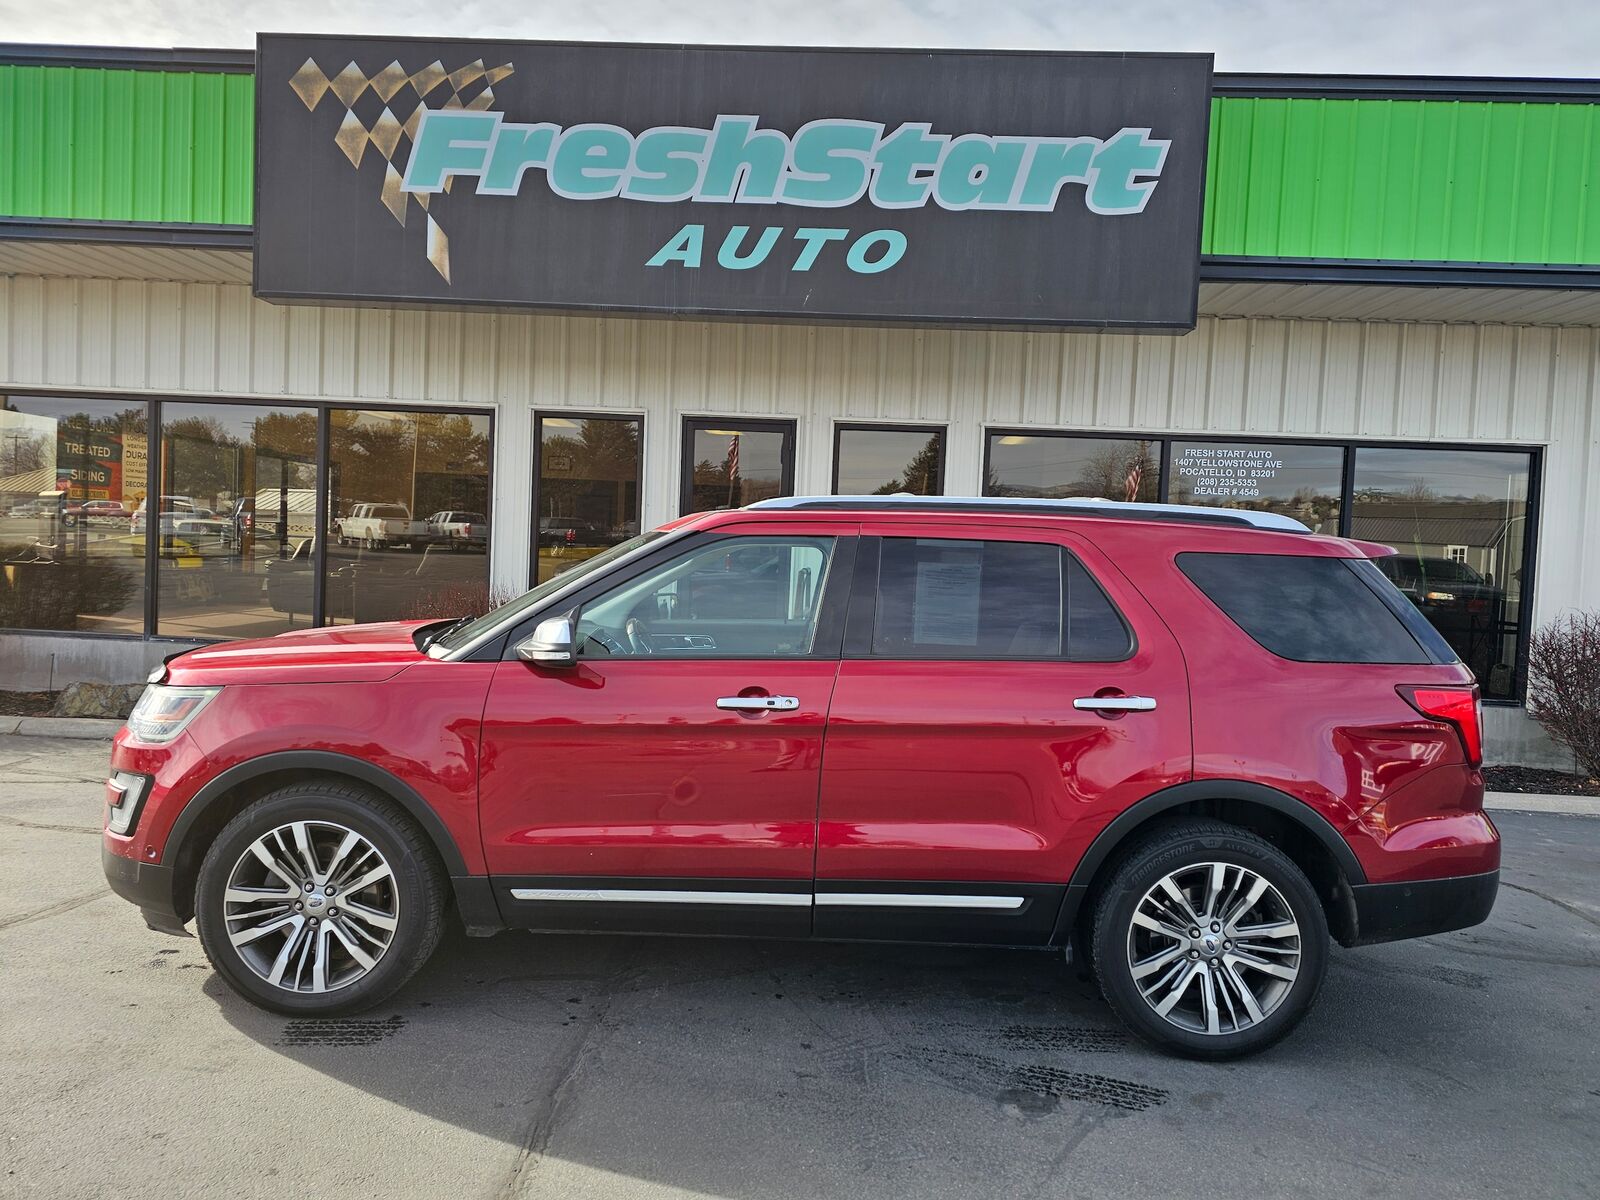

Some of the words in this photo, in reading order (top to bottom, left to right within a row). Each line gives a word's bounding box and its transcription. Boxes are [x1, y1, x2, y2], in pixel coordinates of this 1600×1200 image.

[645, 223, 908, 275] AUTO
[65, 442, 111, 458] TREATED
[1185, 449, 1215, 457] FRESH
[1216, 450, 1245, 458] START
[1247, 450, 1272, 459] AUTO
[1195, 459, 1263, 468] YELLOWSTONE
[1265, 461, 1282, 469] AVE
[71, 469, 105, 482] SIDING
[1179, 468, 1235, 478] POCATELLO,
[1237, 469, 1246, 477] ID
[1250, 469, 1275, 478] 83201
[1197, 478, 1218, 486] (208)
[1219, 478, 1257, 487] 235-5353
[1194, 487, 1230, 496] DEALER
[1238, 488, 1259, 496] 4549
